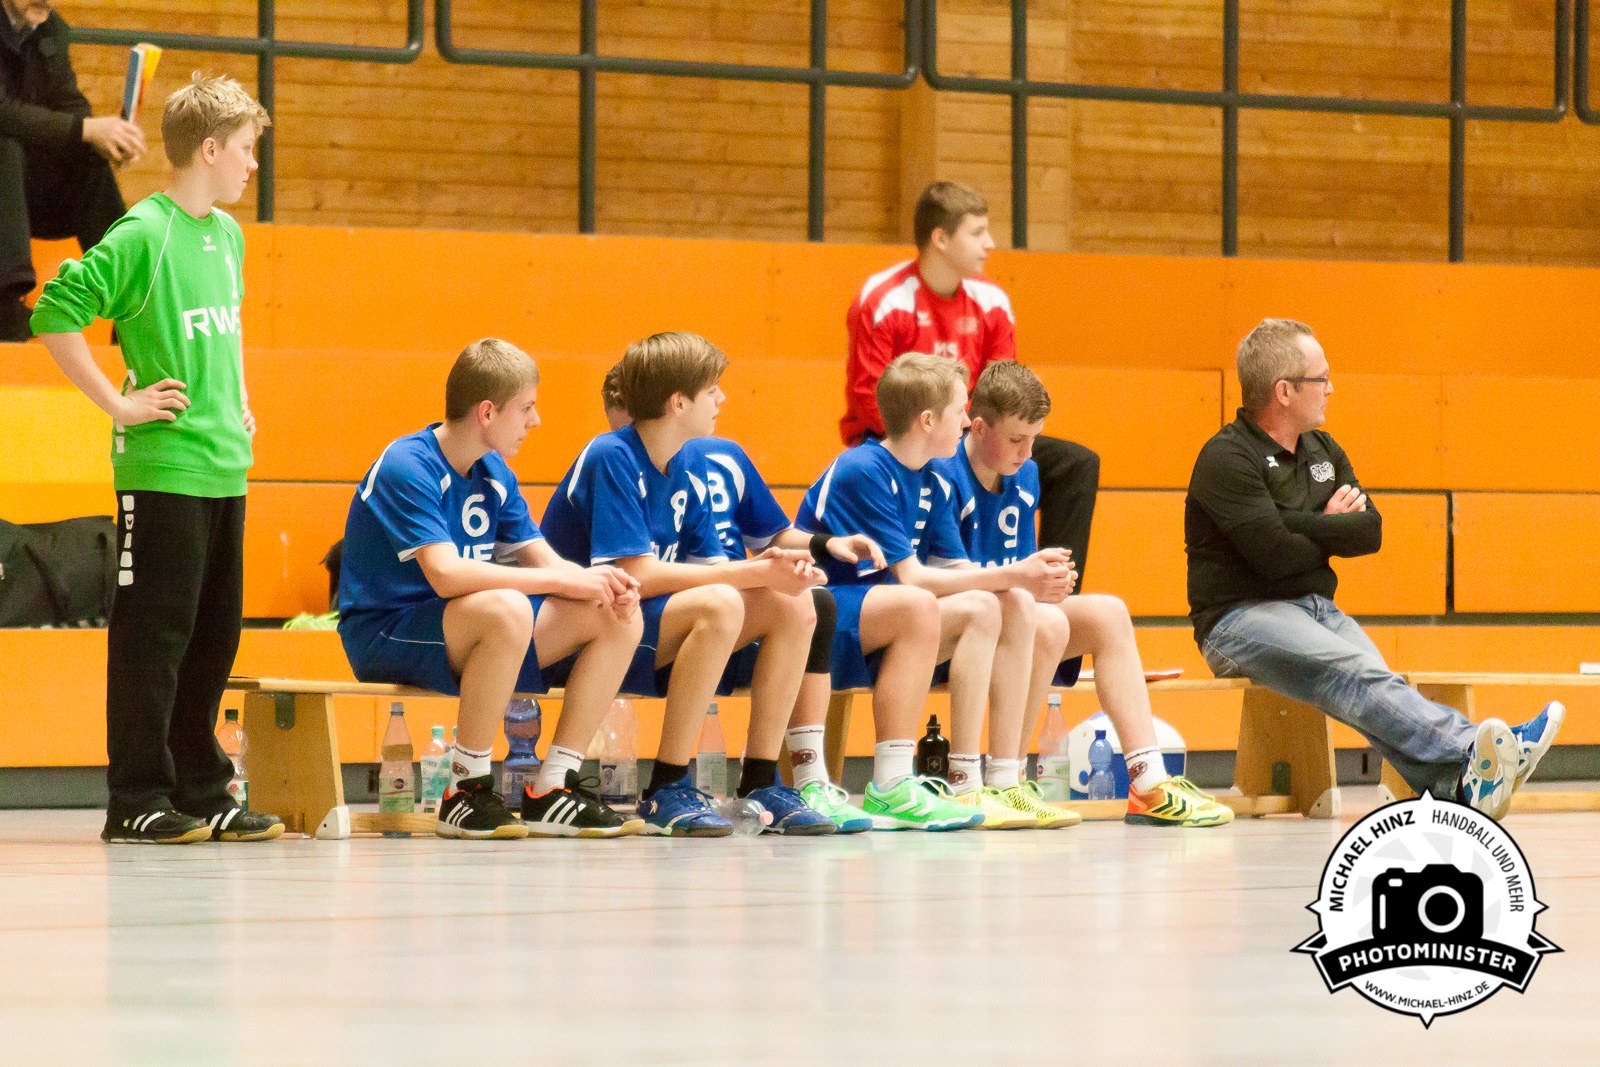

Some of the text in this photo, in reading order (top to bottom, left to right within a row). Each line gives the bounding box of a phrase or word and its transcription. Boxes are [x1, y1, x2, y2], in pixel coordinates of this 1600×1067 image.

[461, 493, 490, 538] 6
[670, 489, 689, 533] 8
[997, 505, 1020, 549] 9
